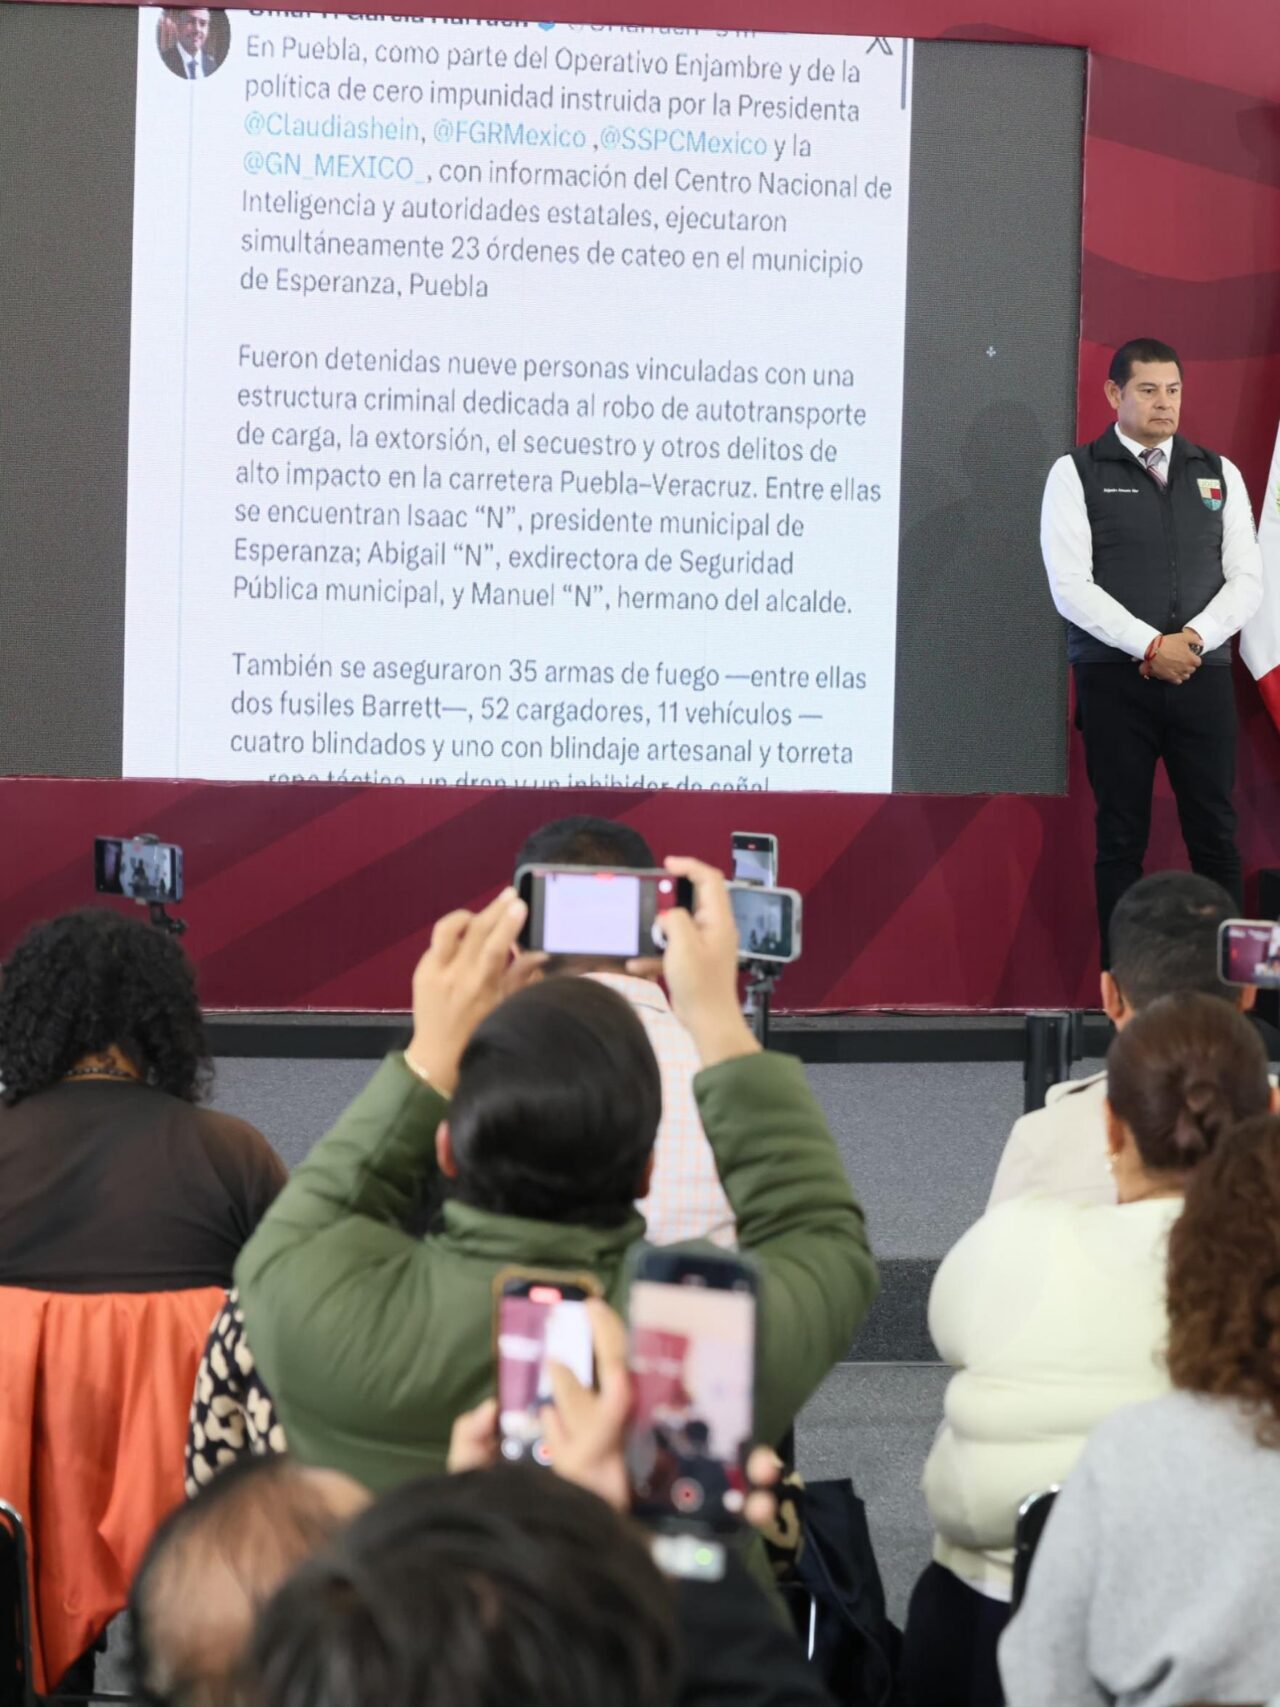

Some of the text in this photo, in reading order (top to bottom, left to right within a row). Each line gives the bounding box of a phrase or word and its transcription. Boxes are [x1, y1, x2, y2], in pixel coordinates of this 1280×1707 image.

[247, 34, 860, 86] En Puebla, como parte del Operativo Enjambre y de la
[246, 73, 859, 122] política de cero impunidad instruida por la Presidenta
[774, 138, 786, 163] y
[793, 132, 811, 158] la
[439, 163, 482, 183] con
[490, 159, 626, 189] información
[634, 165, 668, 191] del
[675, 168, 752, 194] Centro
[759, 171, 858, 199] Nacional
[864, 175, 892, 200] de
[243, 189, 786, 234] Inteligencia y autoridades estatales, ejecutaron
[241, 227, 863, 279] simultáneamente 23 órdenes de cateo en el municipio
[240, 266, 488, 298] de Esperanza, Puebla
[239, 343, 854, 388] Fueron detenidas nueve personas vinculadas con una
[238, 384, 866, 430] estructura criminal dedicada al robo de autotransporte
[237, 420, 837, 463] de carga, la extorsión, el secuestro y otros delitos de
[236, 459, 279, 485] alto
[287, 461, 381, 491] impacto
[389, 469, 415, 489] en
[423, 464, 441, 489] la
[449, 469, 552, 493] carretera
[766, 475, 824, 502] Entre
[830, 476, 881, 503] ellas
[235, 503, 260, 523] se
[268, 503, 400, 526] encuentran
[408, 503, 467, 529] Isaac
[531, 507, 652, 536] presidente
[660, 510, 769, 541] municipal
[777, 512, 804, 538] de
[235, 537, 360, 568] Esperanza;
[368, 539, 445, 572] Abigail
[509, 544, 638, 572] exdirectora
[645, 547, 672, 573] de
[680, 548, 793, 580] Seguridad
[234, 575, 317, 601] Pública
[326, 578, 444, 609] municipal,
[452, 586, 464, 611] y
[472, 581, 554, 607] Manuel
[618, 584, 718, 611] hermano
[725, 587, 758, 612] del
[766, 588, 851, 614] alcalde.
[232, 652, 332, 678] También
[341, 659, 366, 679] se
[373, 659, 501, 686] aseguraron
[509, 658, 537, 683] 35
[545, 665, 614, 684] armas
[621, 660, 650, 686] de
[656, 661, 719, 692] fuego
[816, 665, 866, 690] ellas
[231, 689, 273, 716] dos
[280, 689, 354, 718] fusiles
[482, 696, 509, 721] 52
[516, 698, 650, 728] cargadores,
[658, 700, 677, 724] 11
[685, 700, 792, 727] vehículos
[231, 730, 852, 769] cuatro blindados y uno con blindaje artesanal y torreta
